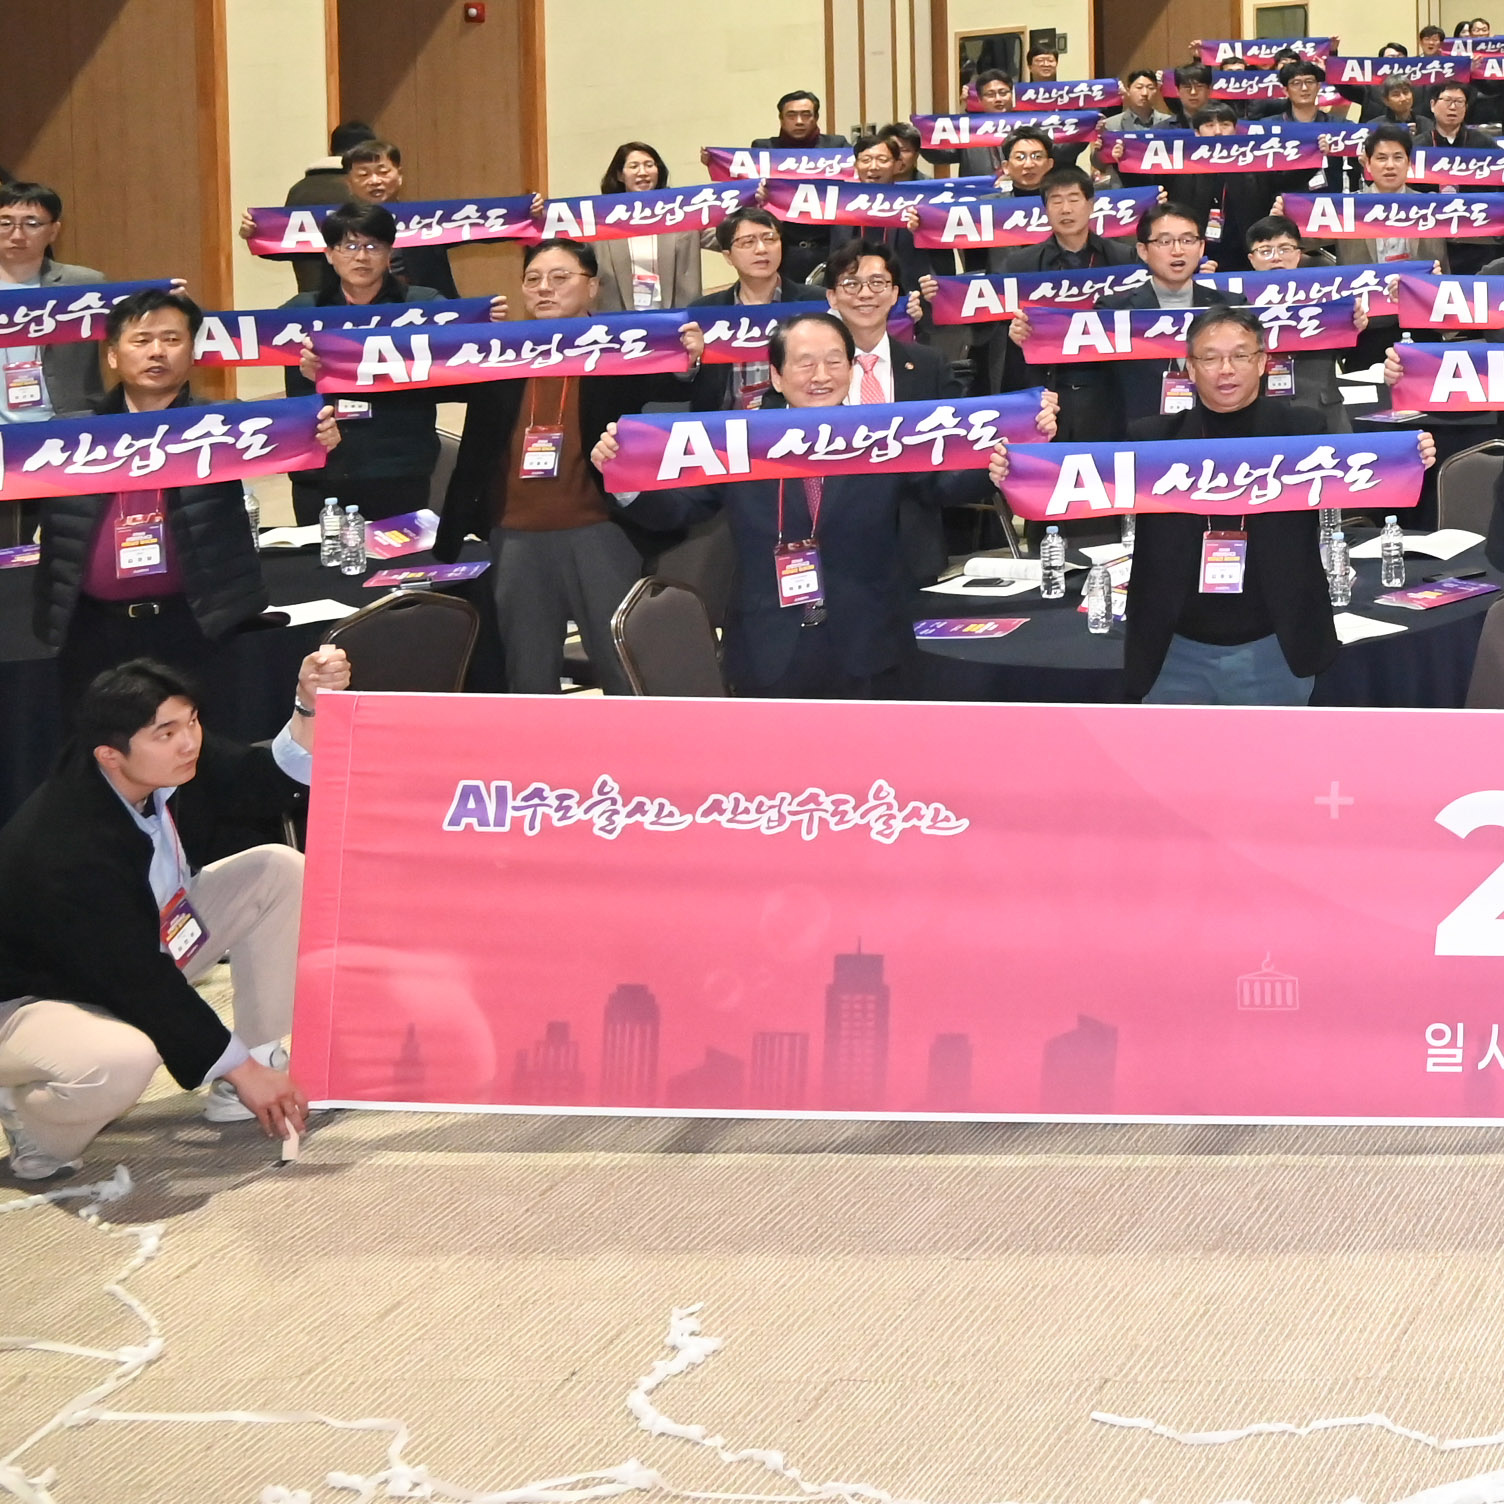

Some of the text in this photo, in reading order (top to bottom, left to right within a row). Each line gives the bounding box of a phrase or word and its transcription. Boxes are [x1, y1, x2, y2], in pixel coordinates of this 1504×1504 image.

[1215, 42, 1243, 63] AI
[1450, 39, 1474, 60] AI
[1341, 59, 1455, 83] AI 산업수도
[1021, 82, 1104, 107] 산업수도
[931, 116, 970, 145] AI
[729, 150, 771, 184] AI
[1140, 137, 1301, 170] AI 산업수도
[541, 187, 740, 240] AI 산업수도
[785, 183, 839, 220] AI
[1305, 197, 1489, 235] AI 산업수도
[940, 204, 994, 243] AI
[961, 277, 1024, 317] AI
[1429, 280, 1488, 324] AI
[194, 316, 259, 360] AI
[1061, 309, 1132, 355] AI
[355, 324, 652, 386] AI 산업수도
[22, 413, 276, 479] 산업수도
[656, 405, 1009, 481] AI 산업수도
[1045, 445, 1381, 516] AI 산업수도
